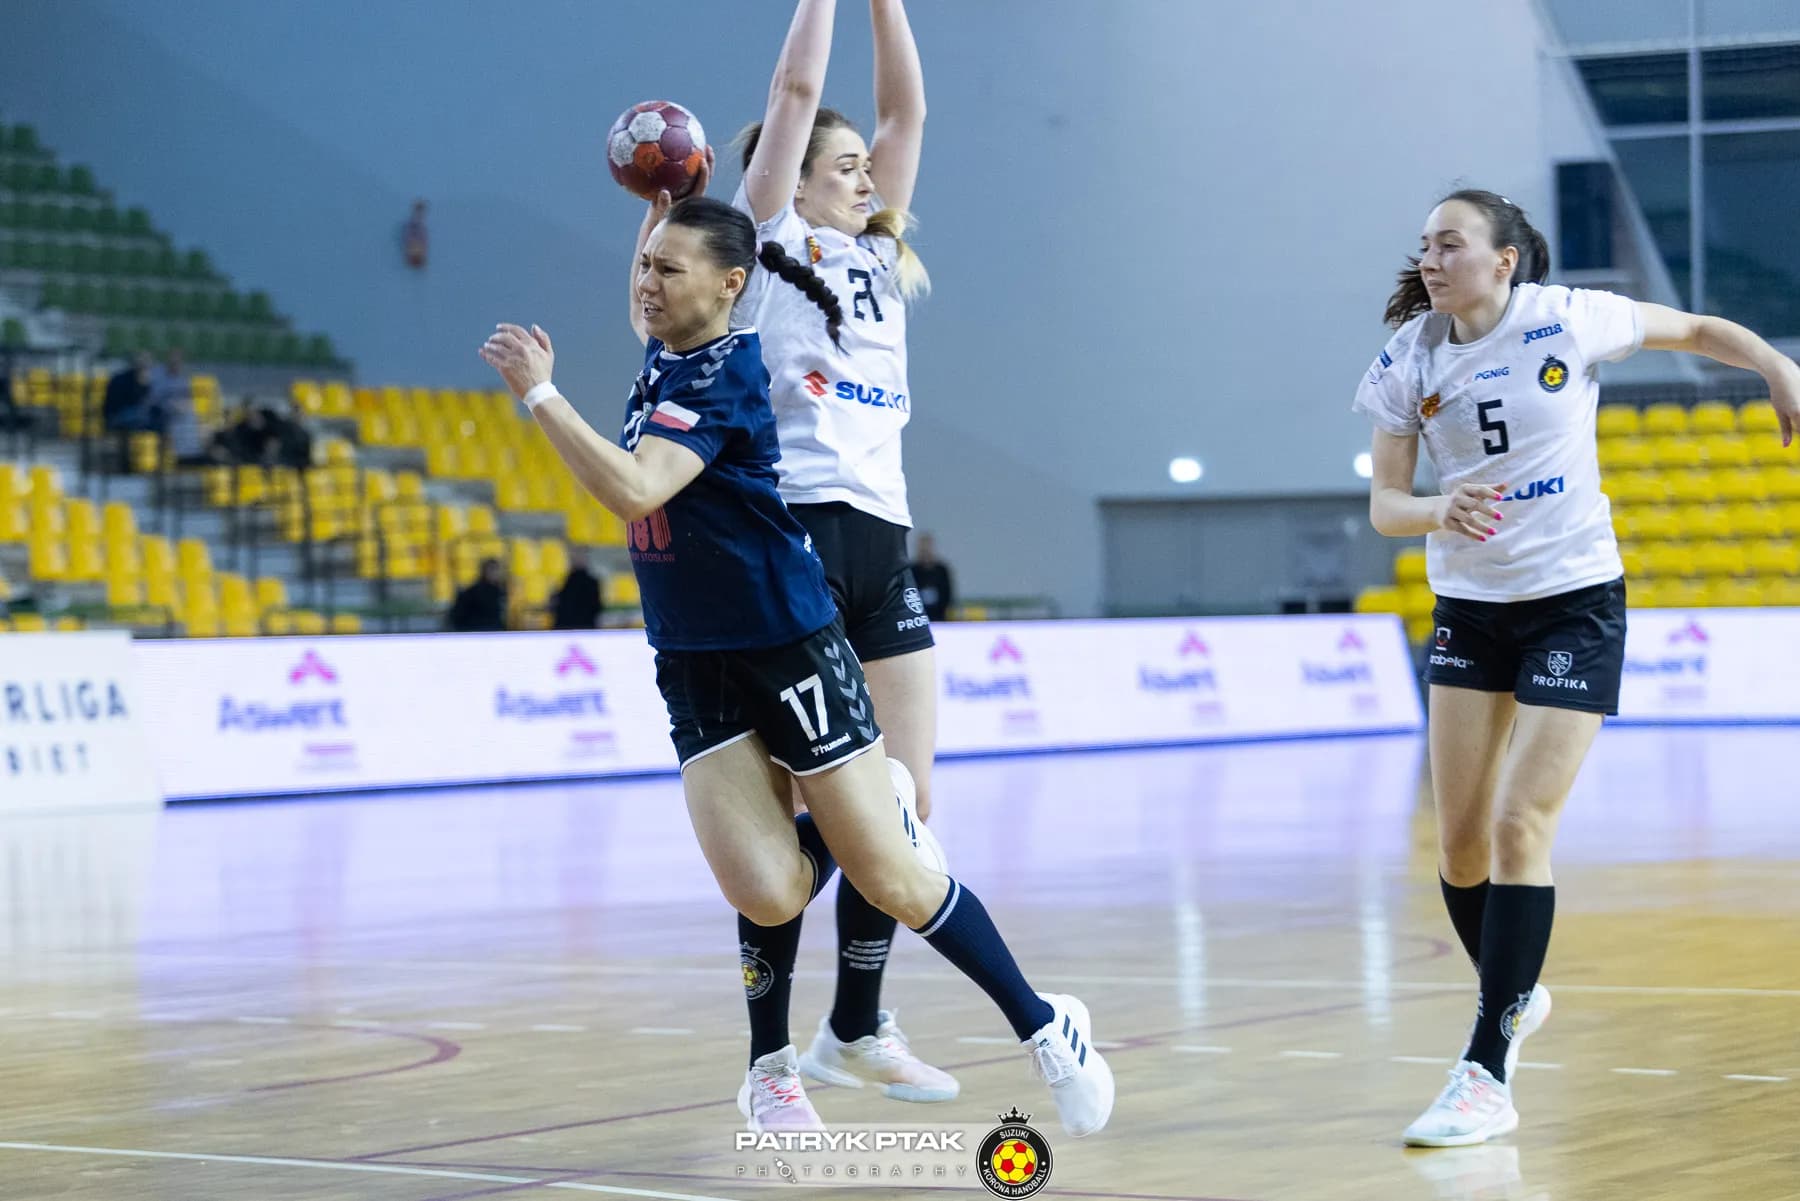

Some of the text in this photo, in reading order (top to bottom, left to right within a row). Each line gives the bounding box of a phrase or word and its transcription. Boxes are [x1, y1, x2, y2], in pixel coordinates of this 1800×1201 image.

[1478, 399, 1509, 455] 5
[1501, 476, 1564, 501] UKI
[1532, 674, 1588, 691] PROFIKA
[780, 673, 829, 741] 17
